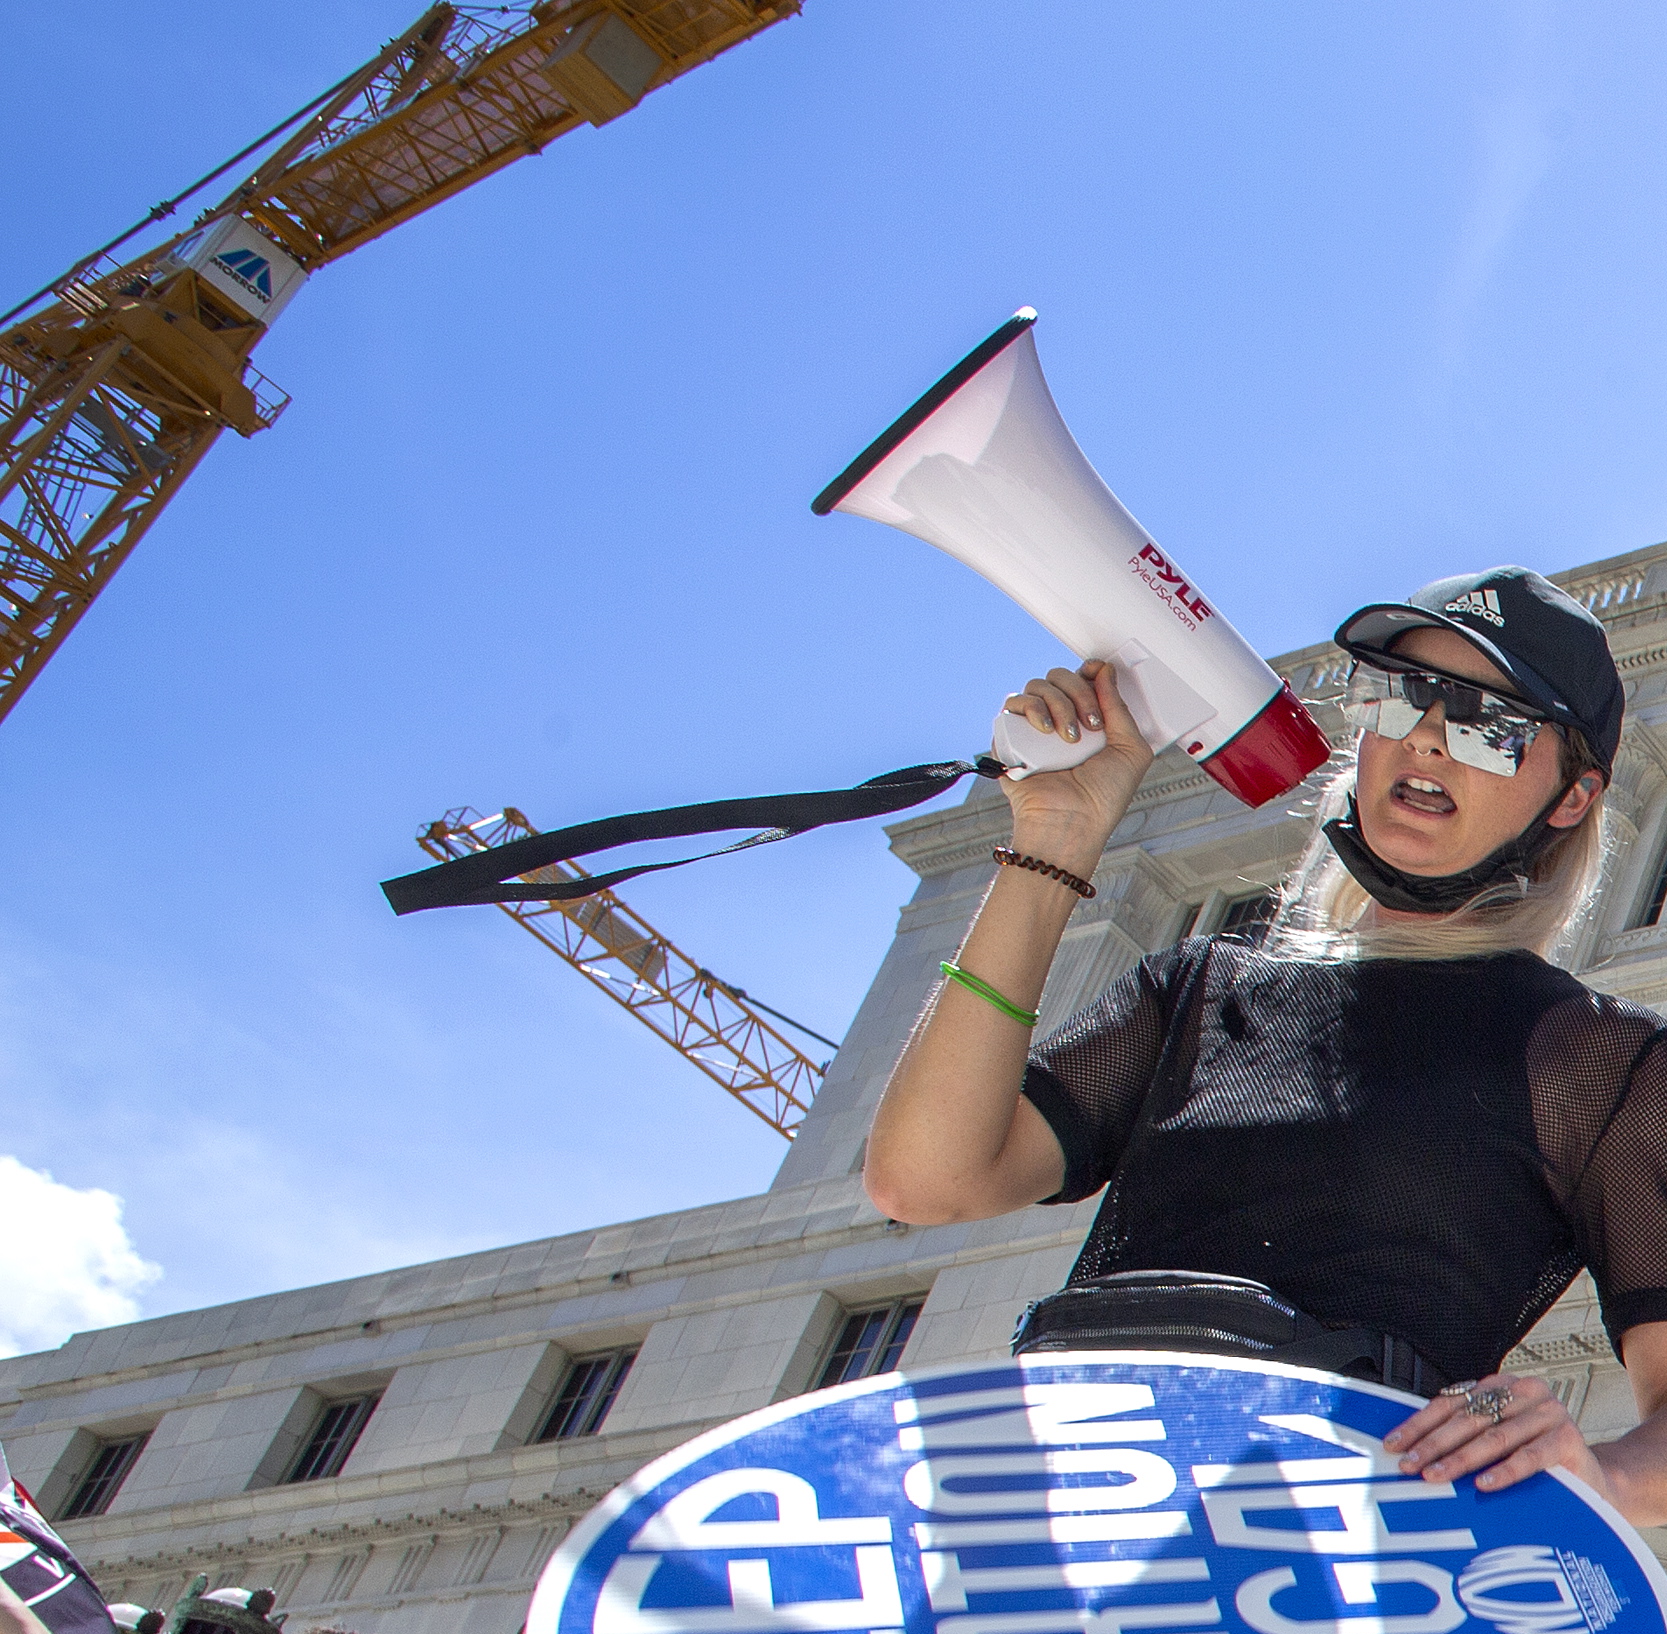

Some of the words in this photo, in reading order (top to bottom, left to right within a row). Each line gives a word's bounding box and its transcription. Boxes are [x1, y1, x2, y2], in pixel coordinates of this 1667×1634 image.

[209, 256, 271, 304] MORROW
[1127, 556, 1197, 632] PyleUSA.com
[1138, 543, 1216, 622] PYLE
[1445, 602, 1505, 628] adidas
